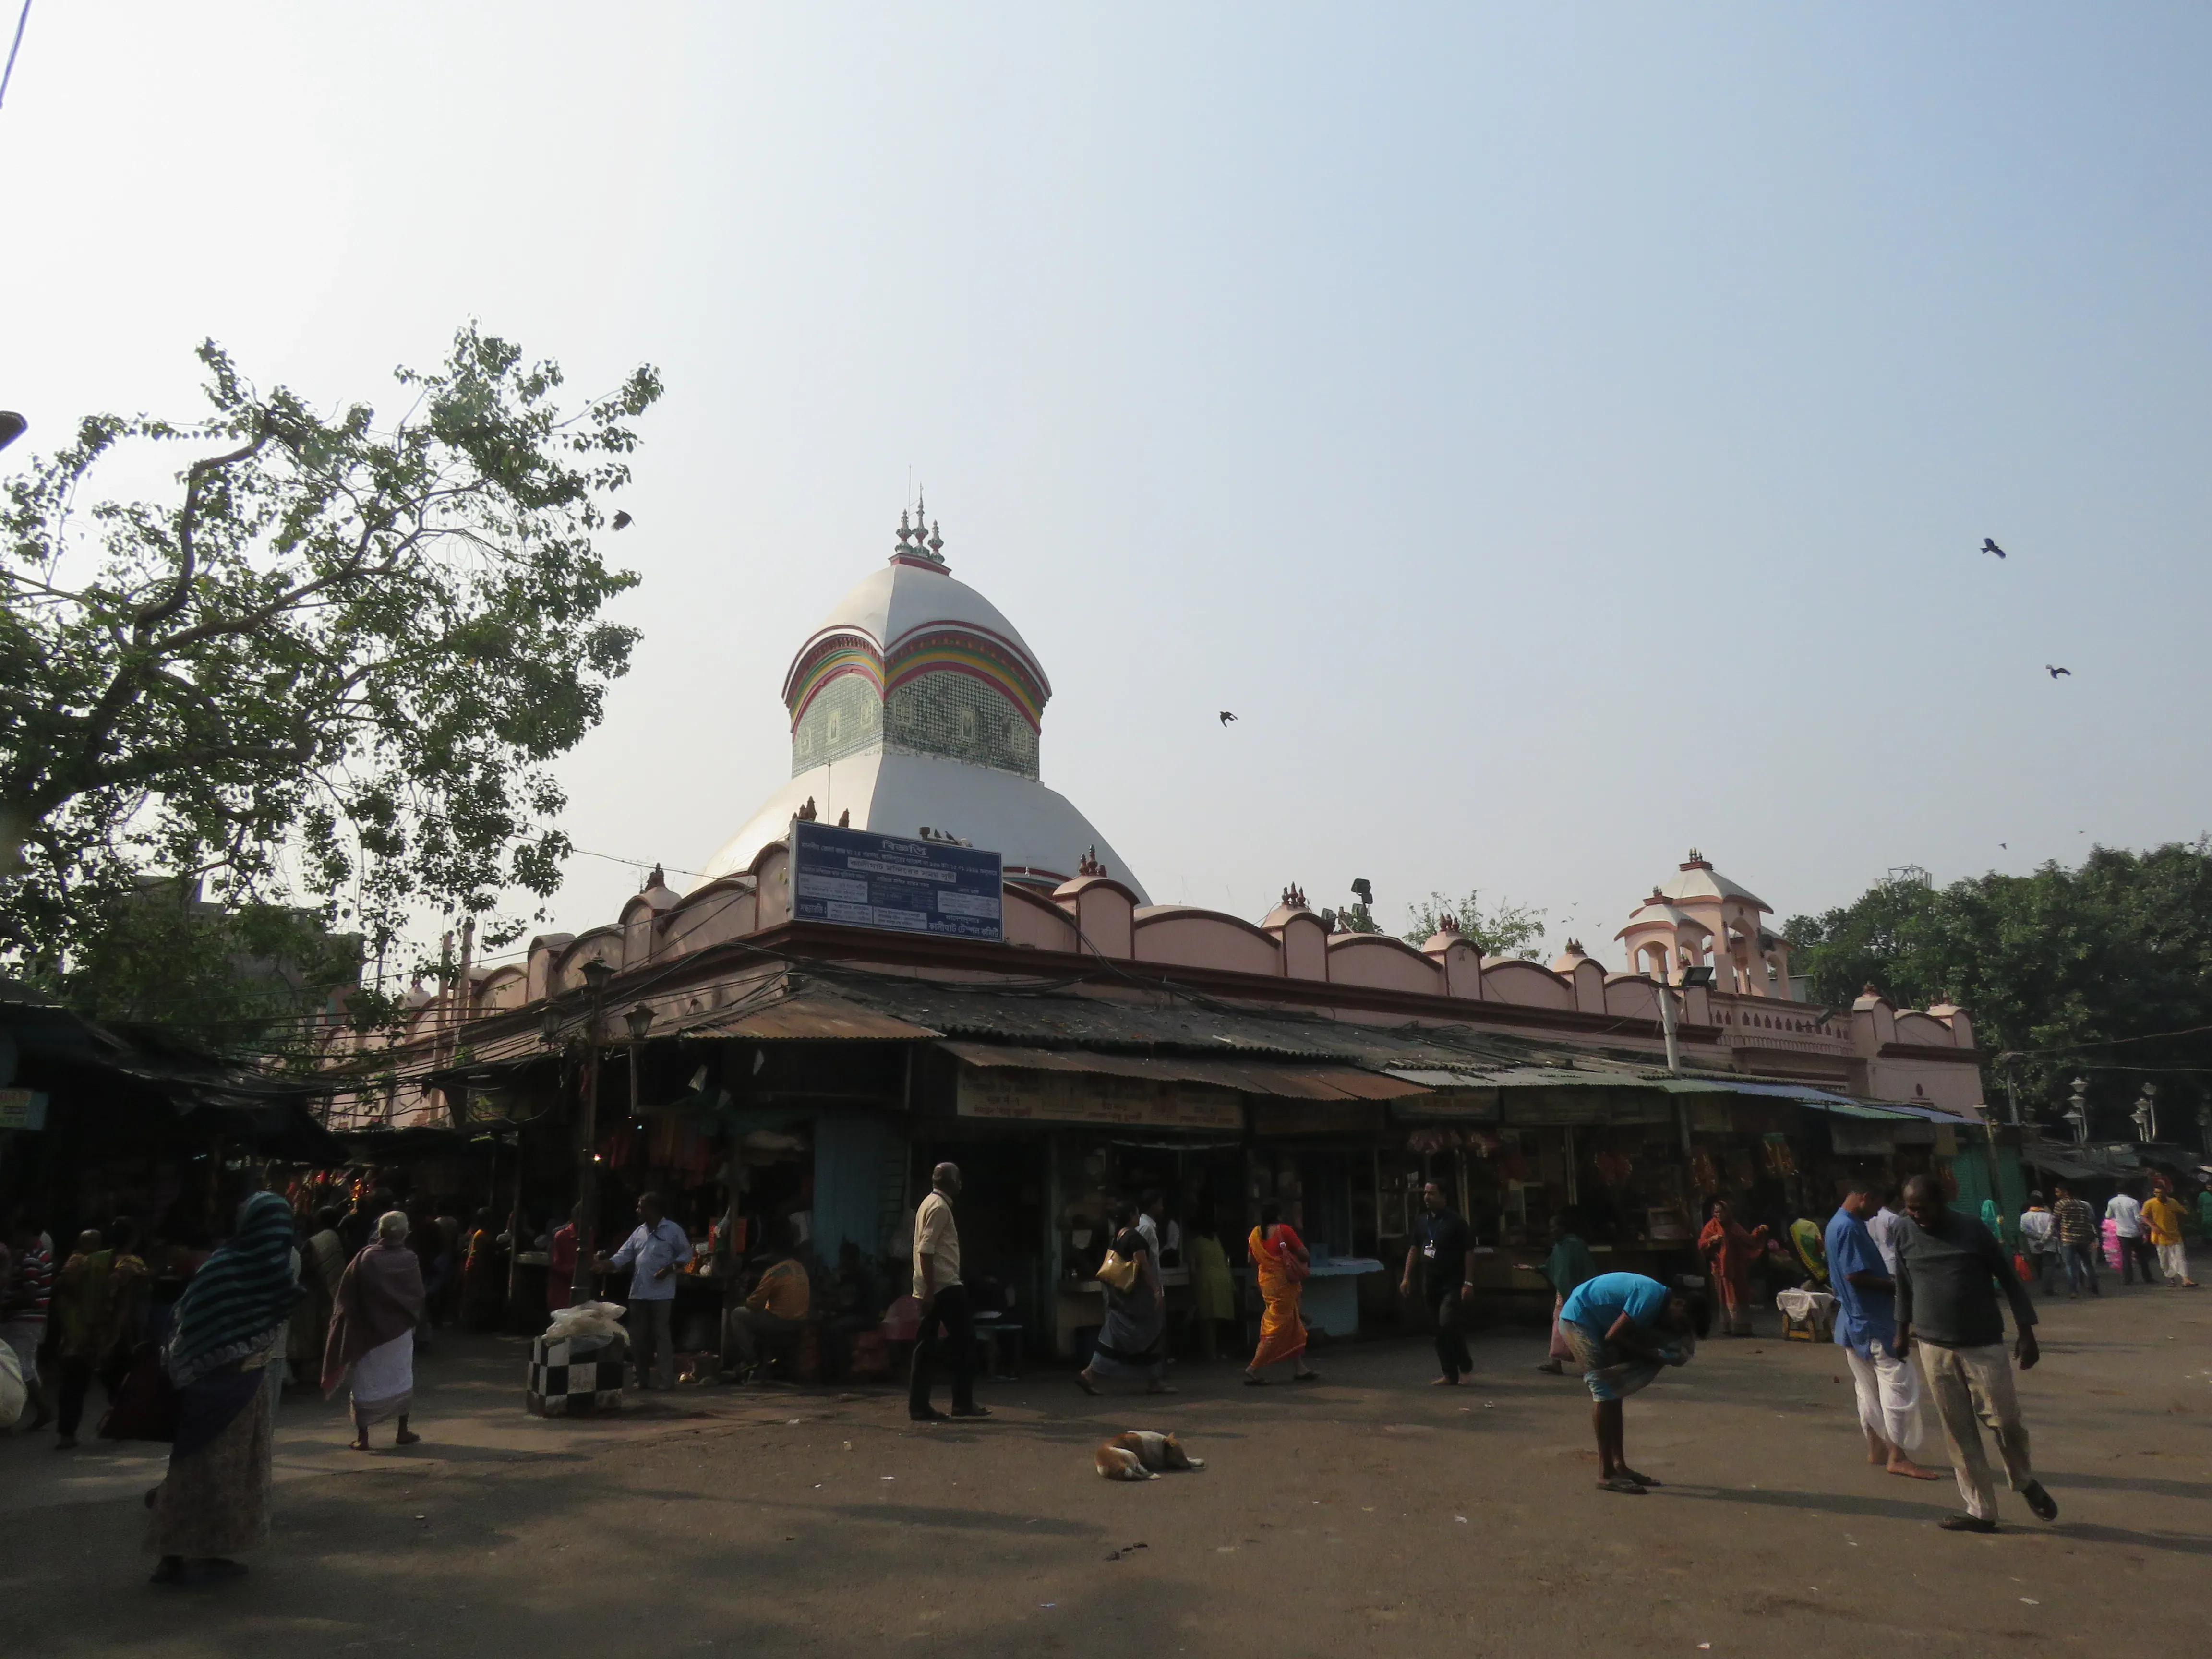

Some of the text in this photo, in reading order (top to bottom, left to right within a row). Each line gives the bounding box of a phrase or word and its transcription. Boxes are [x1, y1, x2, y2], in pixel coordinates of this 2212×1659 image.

[881, 840, 926, 855] বিজ্ঞপ্তি
[850, 859, 883, 870] কালীঘাট
[928, 921, 957, 932] কালীঘাট
